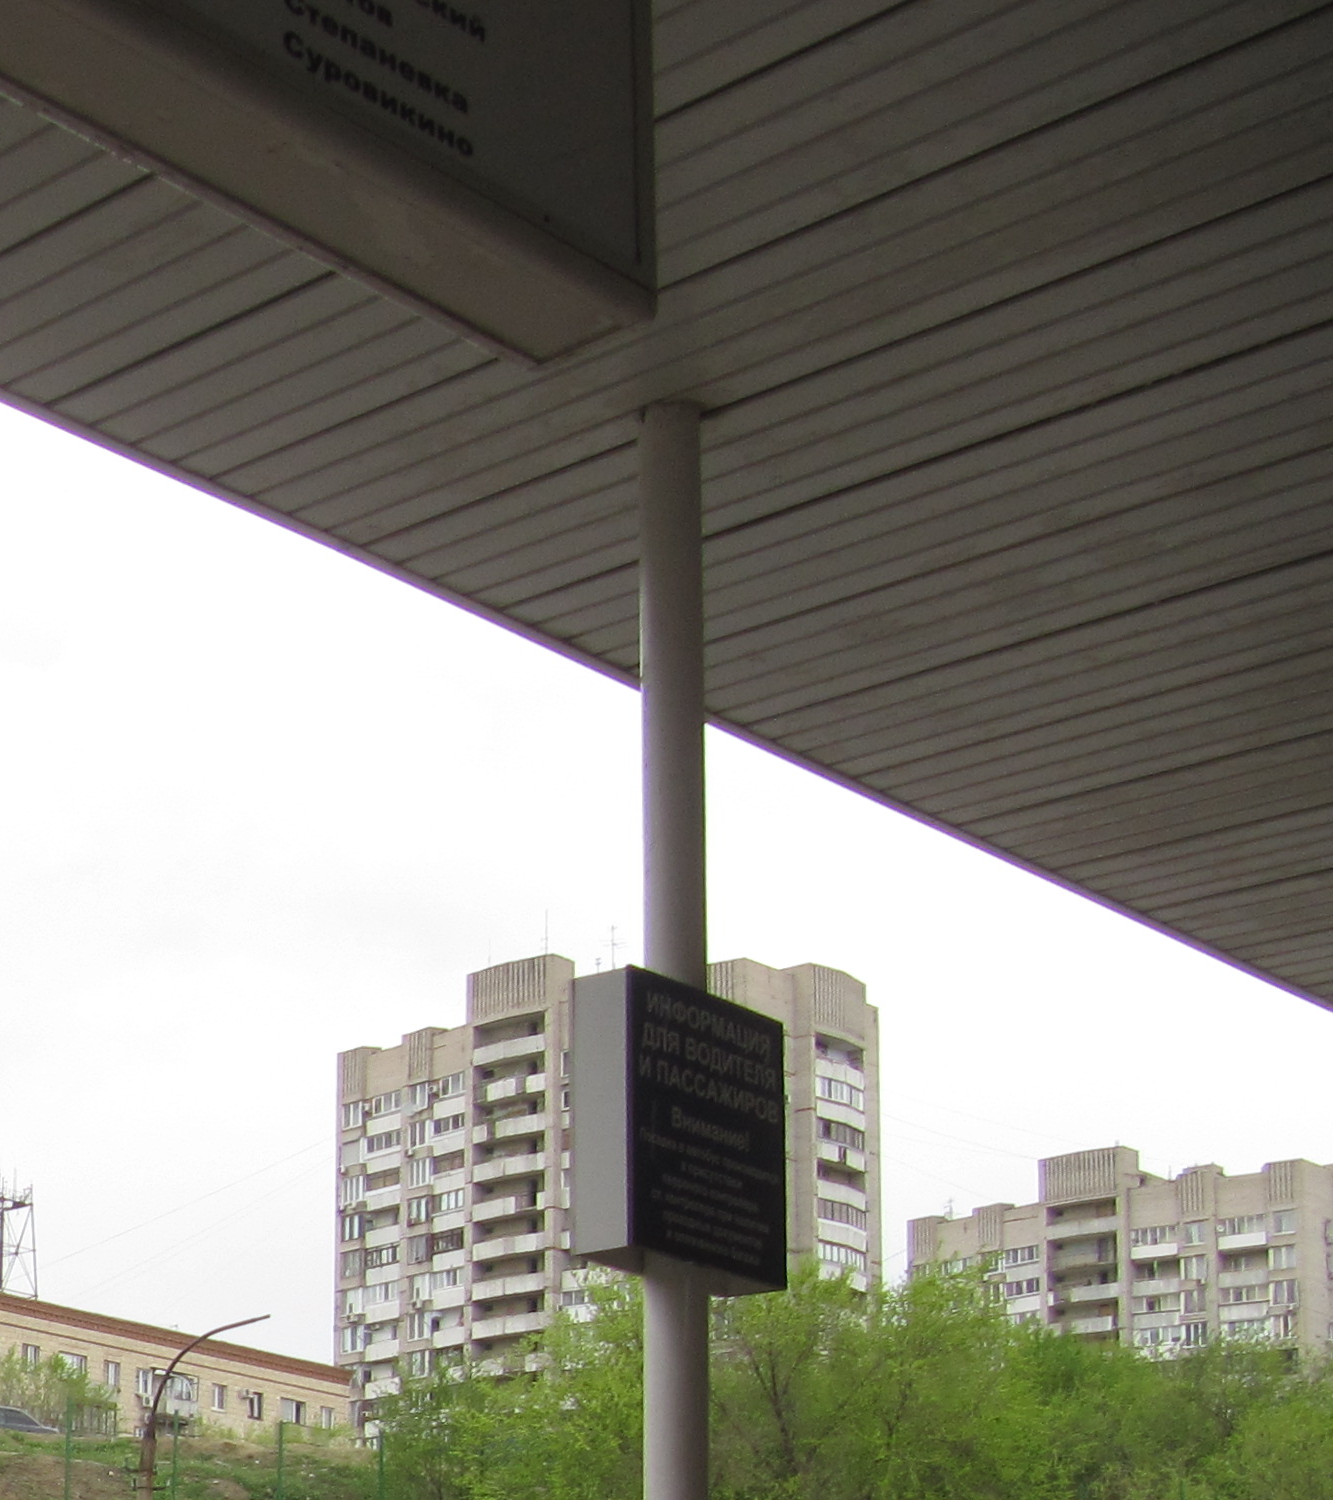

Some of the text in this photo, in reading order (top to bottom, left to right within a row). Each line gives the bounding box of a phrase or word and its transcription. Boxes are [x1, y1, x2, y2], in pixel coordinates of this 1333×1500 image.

[283, 30, 474, 156] Суровикино
[642, 1021, 776, 1093] ДЛЯ ВОДИТЕЛЯ
[648, 992, 770, 1056] ИНФОРМАЦИЯ
[639, 1053, 778, 1125] И ПАССАЖИРОВ
[671, 1105, 749, 1153] Внимание!
